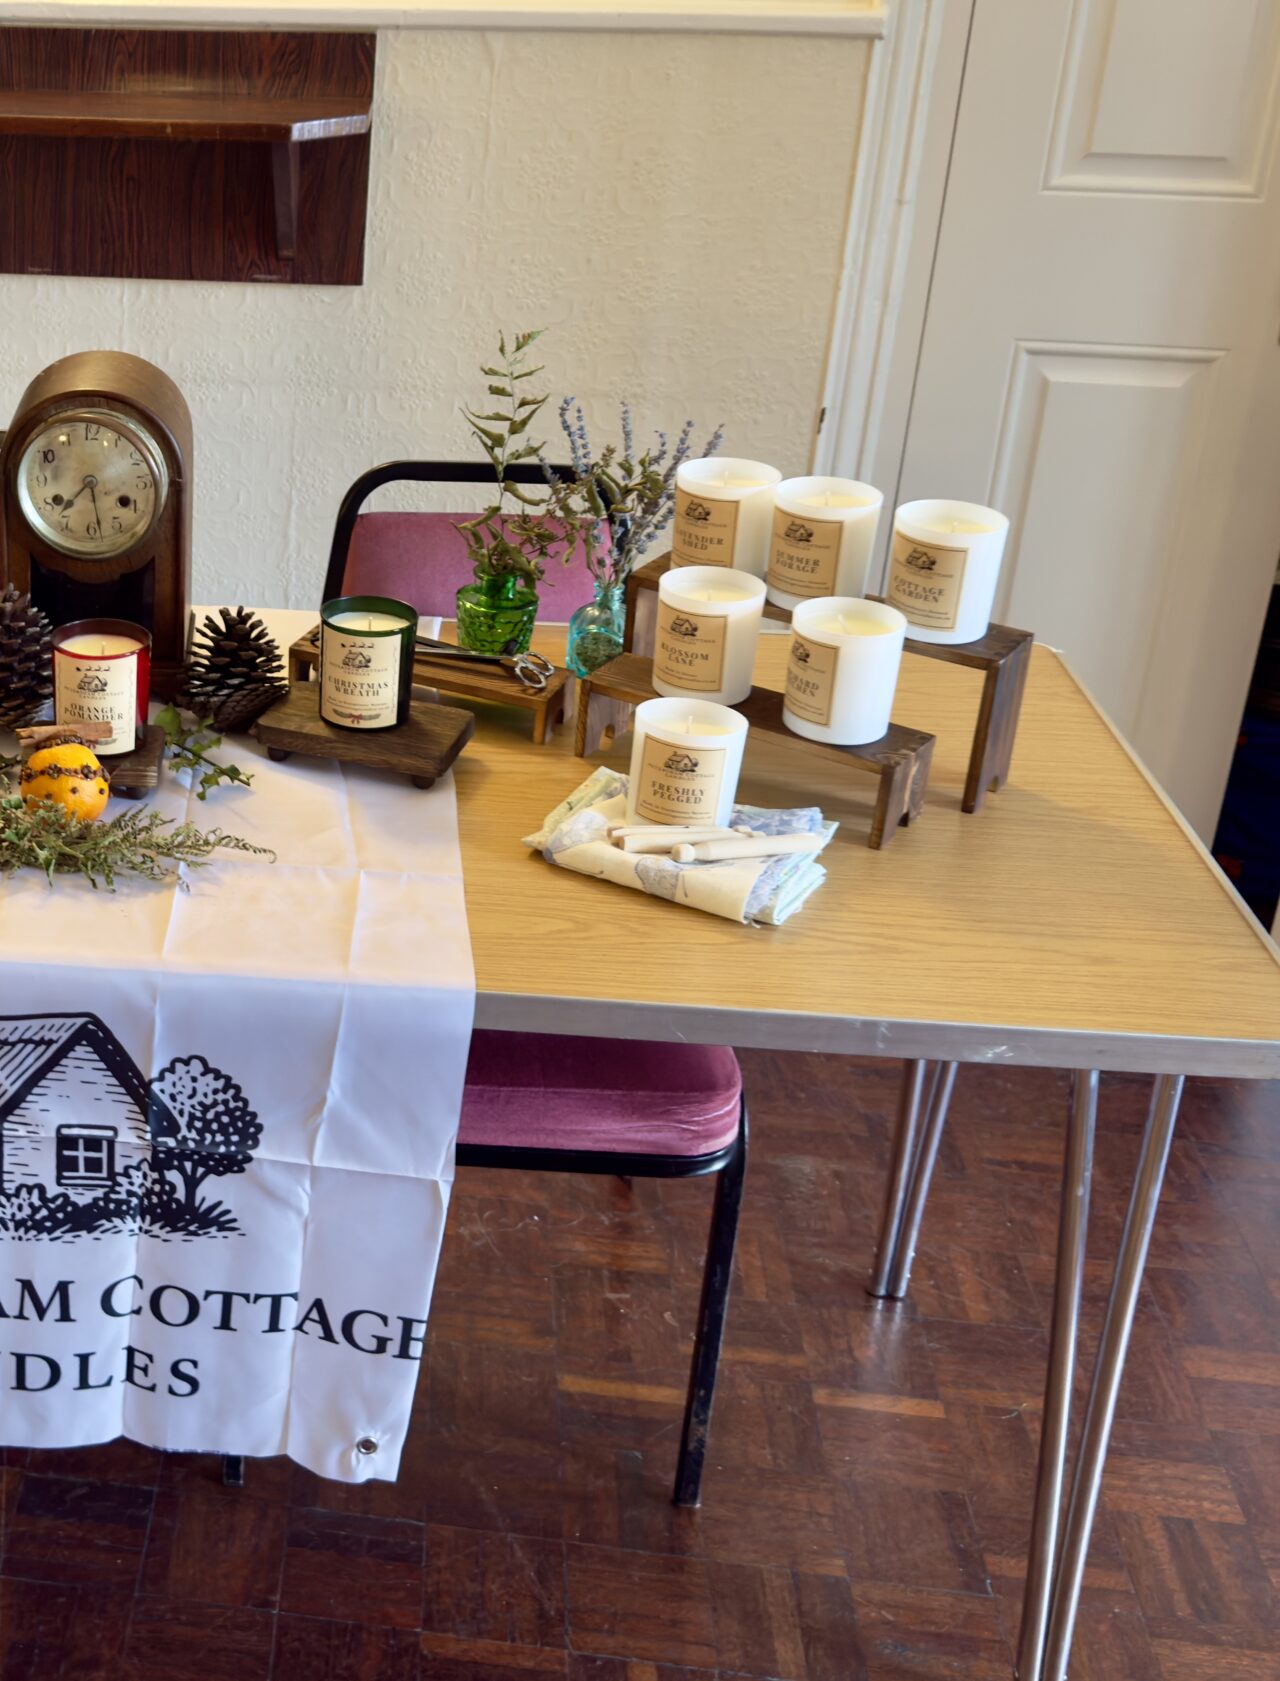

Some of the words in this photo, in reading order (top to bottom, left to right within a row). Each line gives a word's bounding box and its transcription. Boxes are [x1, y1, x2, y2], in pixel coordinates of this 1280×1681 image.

[85, 424, 101, 441] 12
[41, 449, 55, 464] 10
[129, 450, 145, 467] 2
[35, 474, 48, 488] 9
[136, 474, 153, 491] 3
[43, 496, 55, 512] 8
[60, 515, 73, 534] 7
[86, 522, 98, 540] 6
[111, 516, 124, 534] 5
[682, 539, 708, 551] SHED
[775, 557, 817, 574] FORAGE
[776, 549, 820, 567] SUMMER
[894, 575, 945, 597] COTTAGE
[895, 584, 939, 604] GARDEN
[661, 642, 709, 661] BLOSSOM
[668, 653, 696, 668] LANE
[327, 674, 390, 690] CHRISTMAS
[334, 685, 380, 697] WREATH
[64, 707, 124, 721] POMANDER
[69, 703, 116, 715] ORANGE
[651, 780, 705, 797] FRESHLY
[652, 788, 703, 805] PEGGED
[100, 1274, 428, 1361] COTTAGE
